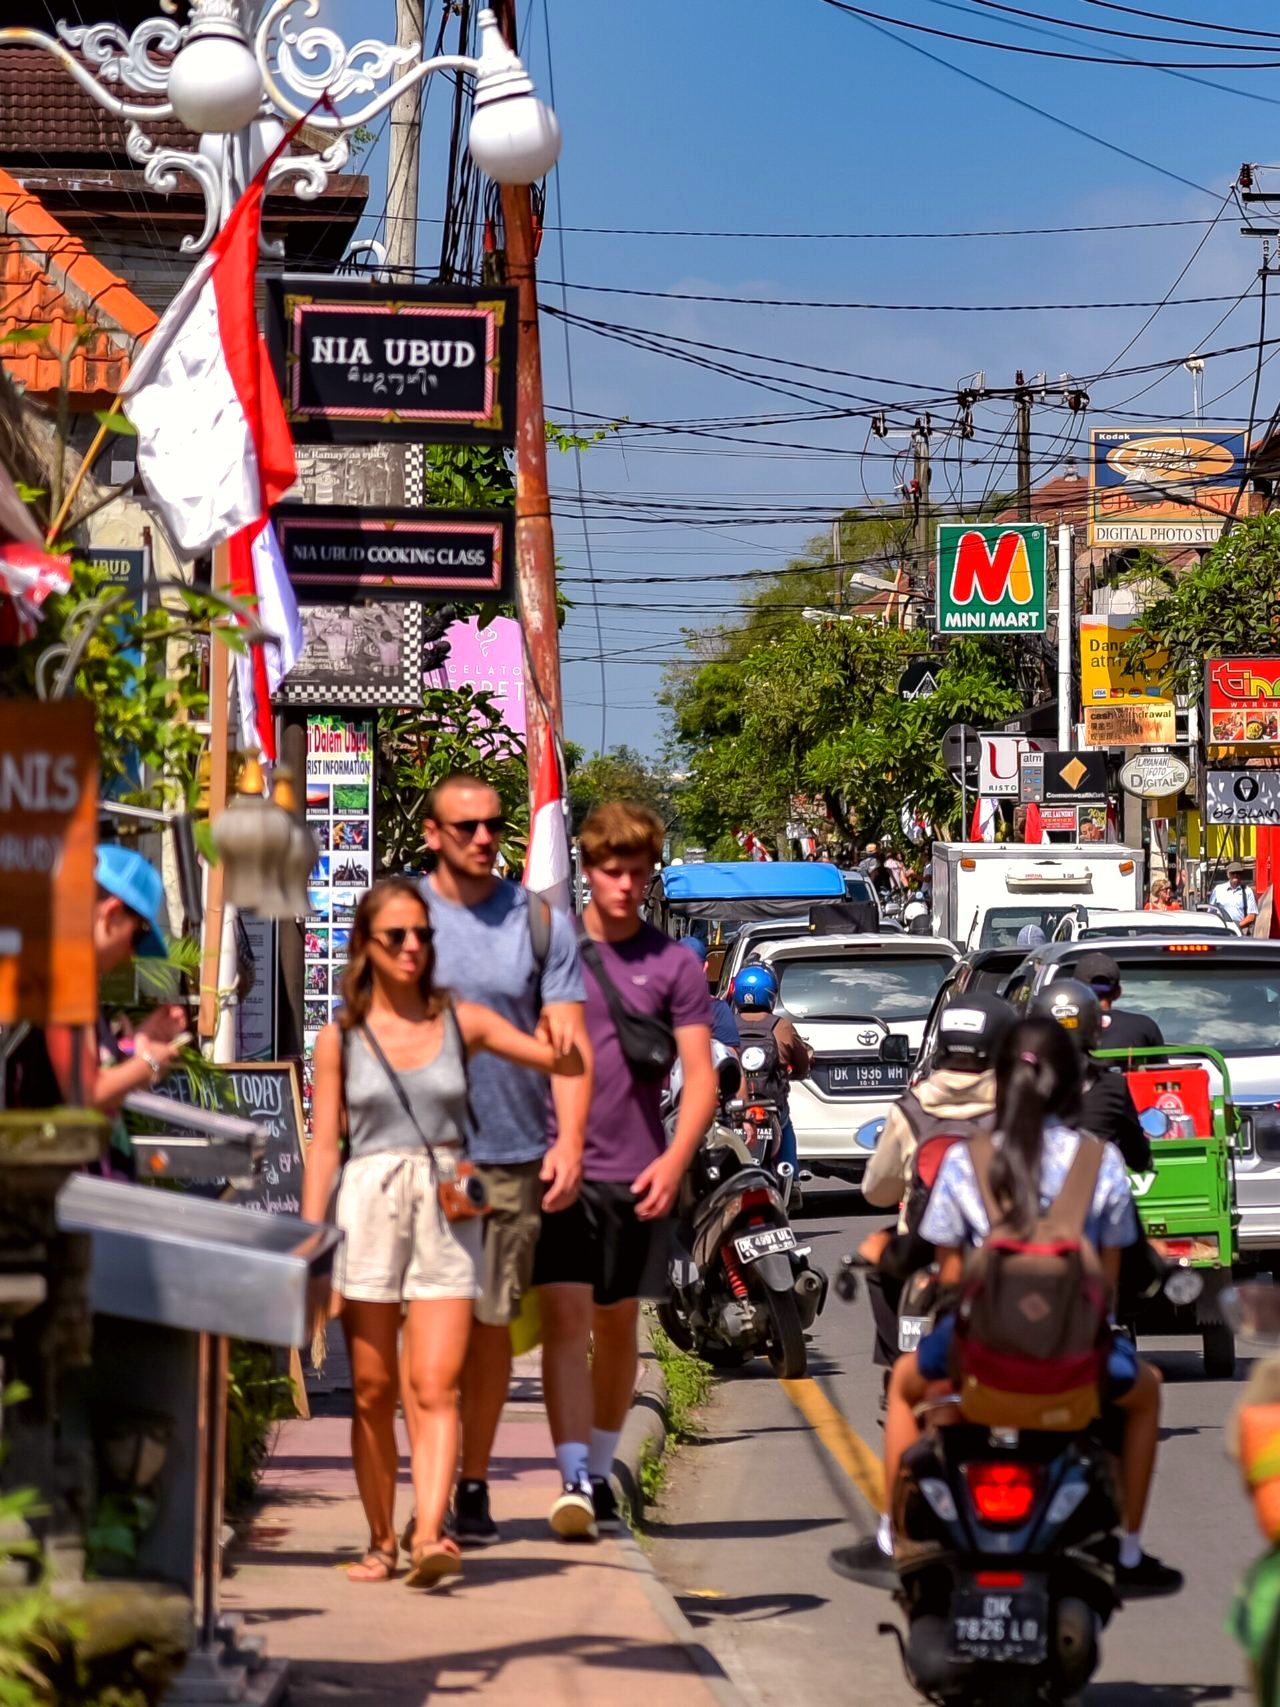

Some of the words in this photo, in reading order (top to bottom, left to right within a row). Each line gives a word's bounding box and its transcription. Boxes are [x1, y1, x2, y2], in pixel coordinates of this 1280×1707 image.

[312, 336, 372, 364] NIA
[384, 339, 476, 368] UBUD
[1136, 447, 1192, 460] Digital
[1096, 528, 1148, 540] DIGITAL
[1150, 528, 1193, 541] PHOTO
[293, 545, 317, 560] NIA
[320, 545, 366, 561] UBUD
[367, 546, 435, 564] COOKING
[436, 549, 486, 566] CLASS
[945, 612, 986, 628] MINI
[989, 612, 1039, 628] MART
[1091, 655, 1121, 668] atm
[448, 664, 522, 676] GELATO
[1091, 711, 1114, 720] cash
[314, 724, 342, 752] Dalem
[345, 724, 368, 753] Ubud
[1023, 754, 1042, 762] atm
[323, 760, 370, 775] INFORMATION
[1148, 768, 1167, 776] FOTO
[1131, 774, 1176, 787] DIGITAL
[1213, 808, 1234, 819] 69
[1237, 808, 1280, 820] SLAM
[834, 1067, 849, 1080] DK
[856, 1066, 882, 1079] 1936
[888, 1066, 903, 1079] WH
[228, 1073, 284, 1117] TODAY
[738, 1239, 753, 1252] DK
[776, 1229, 792, 1242] UL
[902, 1320, 921, 1336] DK
[983, 1595, 1013, 1618] DK
